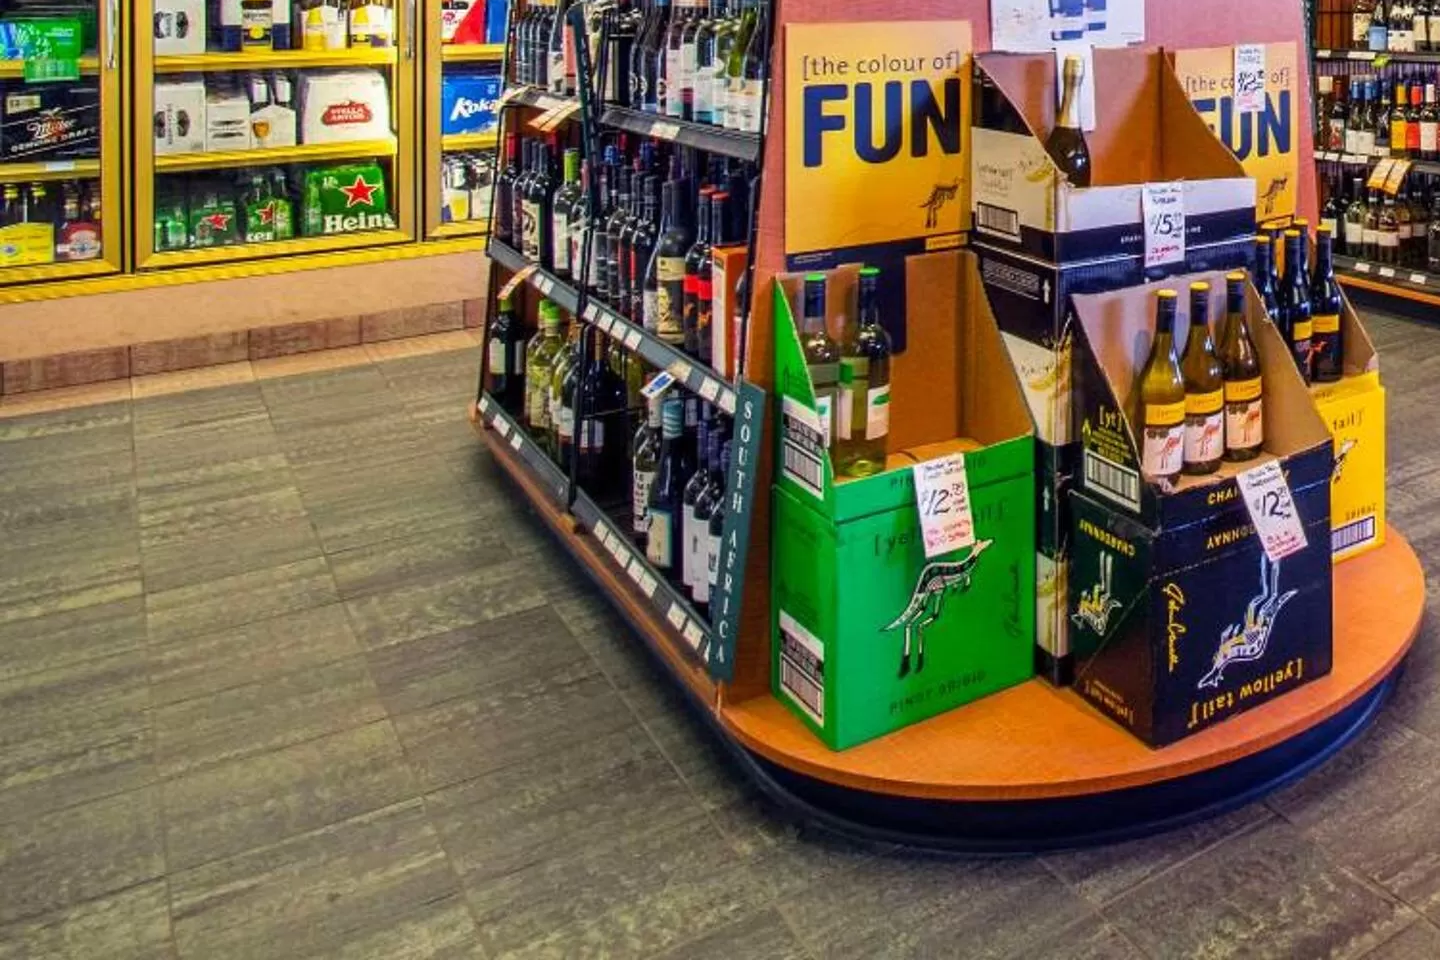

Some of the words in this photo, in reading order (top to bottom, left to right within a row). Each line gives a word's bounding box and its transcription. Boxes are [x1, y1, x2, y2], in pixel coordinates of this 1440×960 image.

[803, 54, 849, 81] [the
[857, 53, 925, 75] colour
[932, 50, 960, 74] of]
[803, 77, 961, 168] FUN
[732, 400, 753, 514] SOUTH
[1207, 524, 1257, 549] DONNAY
[1239, 657, 1304, 697] [yellow
[1186, 695, 1234, 729] tail]
